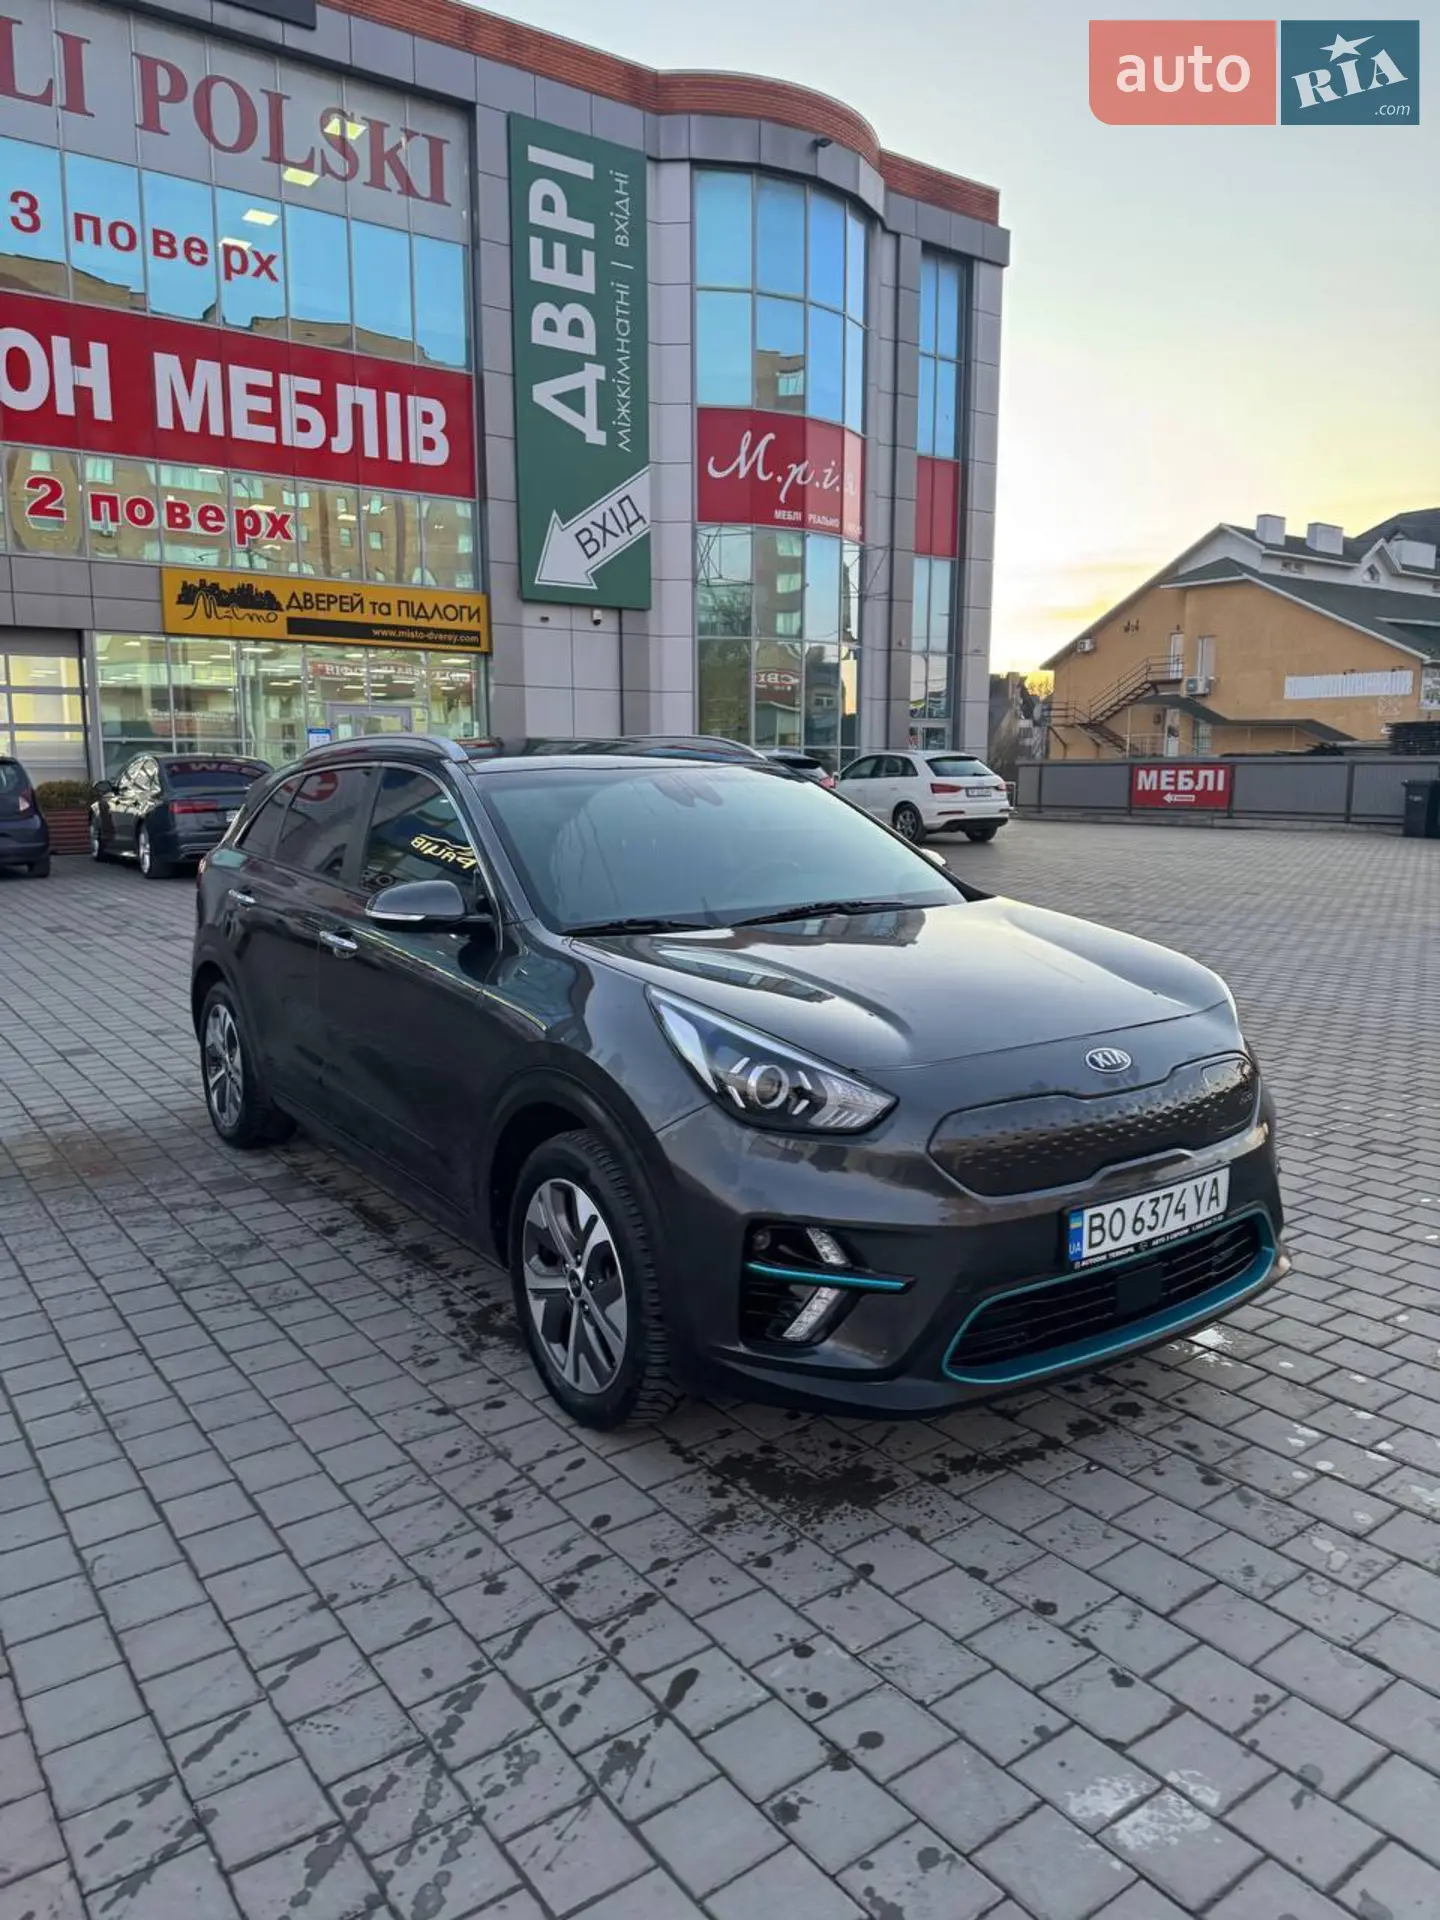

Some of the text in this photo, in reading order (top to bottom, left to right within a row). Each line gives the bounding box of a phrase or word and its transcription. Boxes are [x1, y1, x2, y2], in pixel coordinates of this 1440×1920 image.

[133, 51, 452, 206] POLSKI
[10, 190, 279, 283] 3 поверх
[527, 144, 607, 447] ДВЕРІ
[609, 169, 633, 453] міжкімнатні вхідні
[153, 351, 450, 466] МЕБЛІВ
[24, 475, 295, 549] 2 поверх
[574, 494, 648, 560] ВХІД
[285, 591, 481, 623] ДВЕРЕЙ та ПІДЛОГИ
[1137, 769, 1225, 791] МЕБЛІ
[1068, 1241, 1082, 1254] UA
[1088, 1207, 1126, 1249] BO
[1132, 1187, 1187, 1236] 6374
[1194, 1176, 1221, 1216] YA
